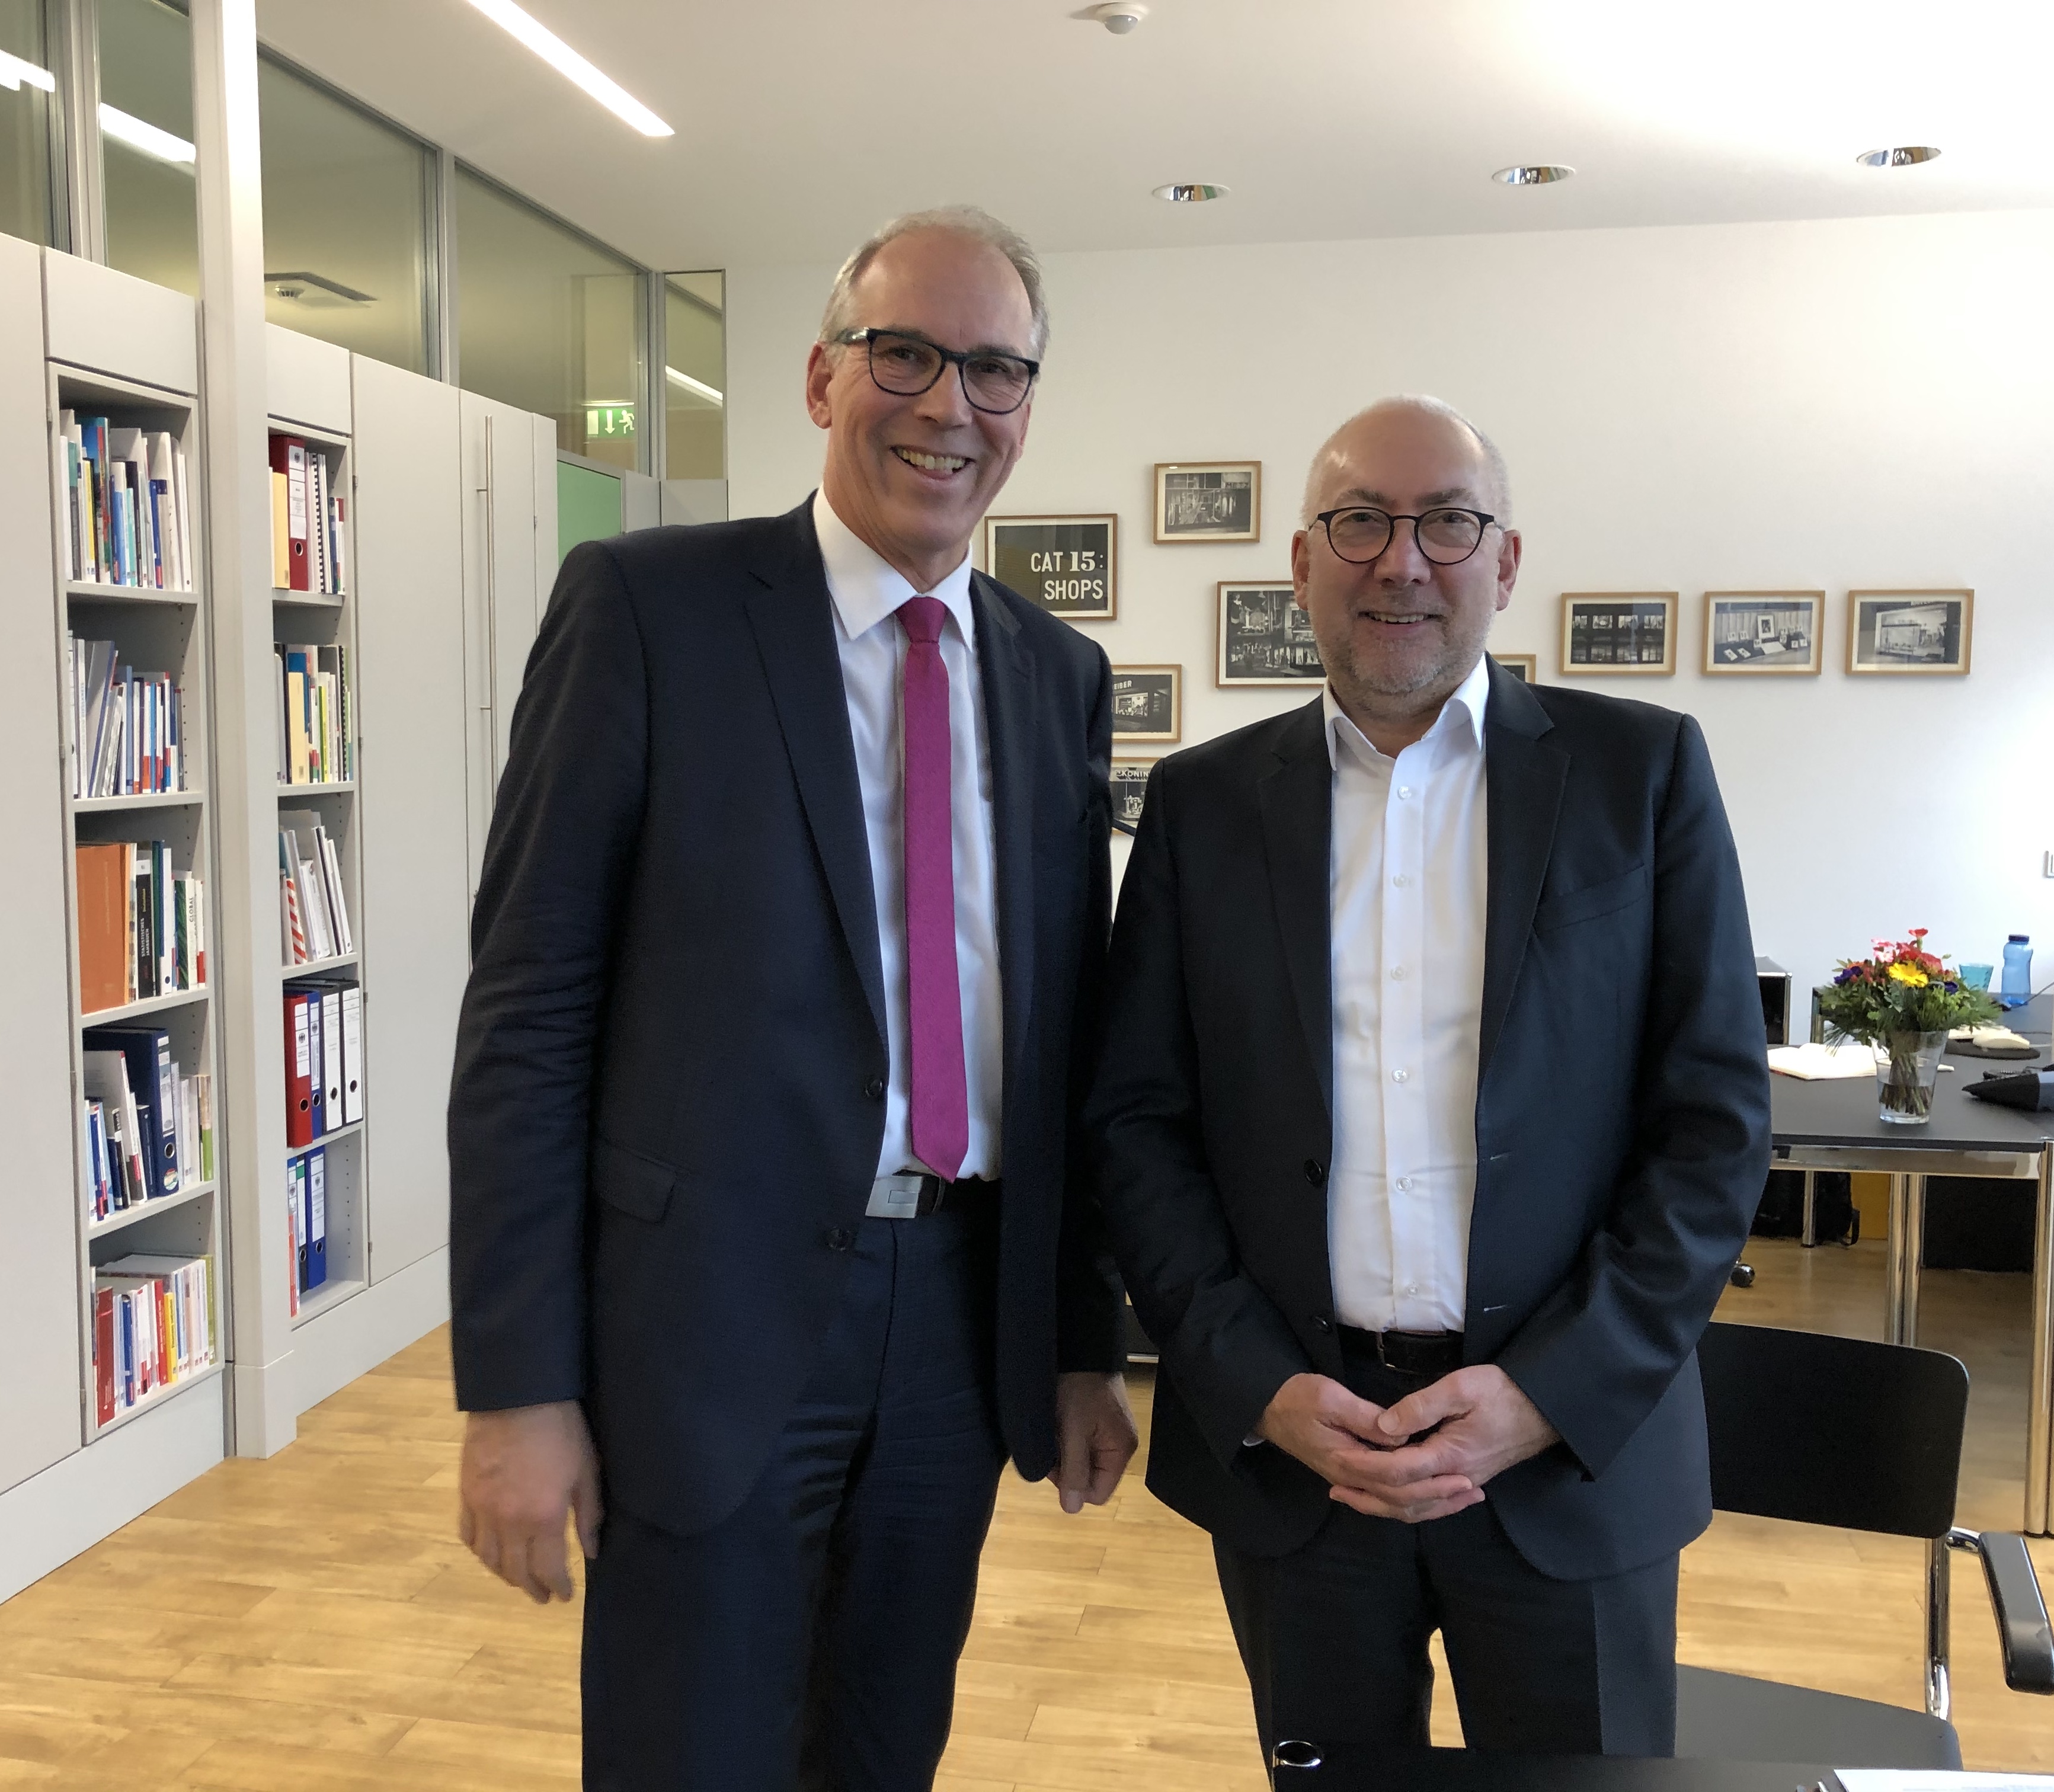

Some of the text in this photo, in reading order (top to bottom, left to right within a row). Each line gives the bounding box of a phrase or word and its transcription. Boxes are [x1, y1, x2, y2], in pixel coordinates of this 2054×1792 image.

[1031, 551, 1103, 572] CAT 15:
[1044, 579, 1103, 600] SHOPS
[1112, 680, 1132, 690] EIBER
